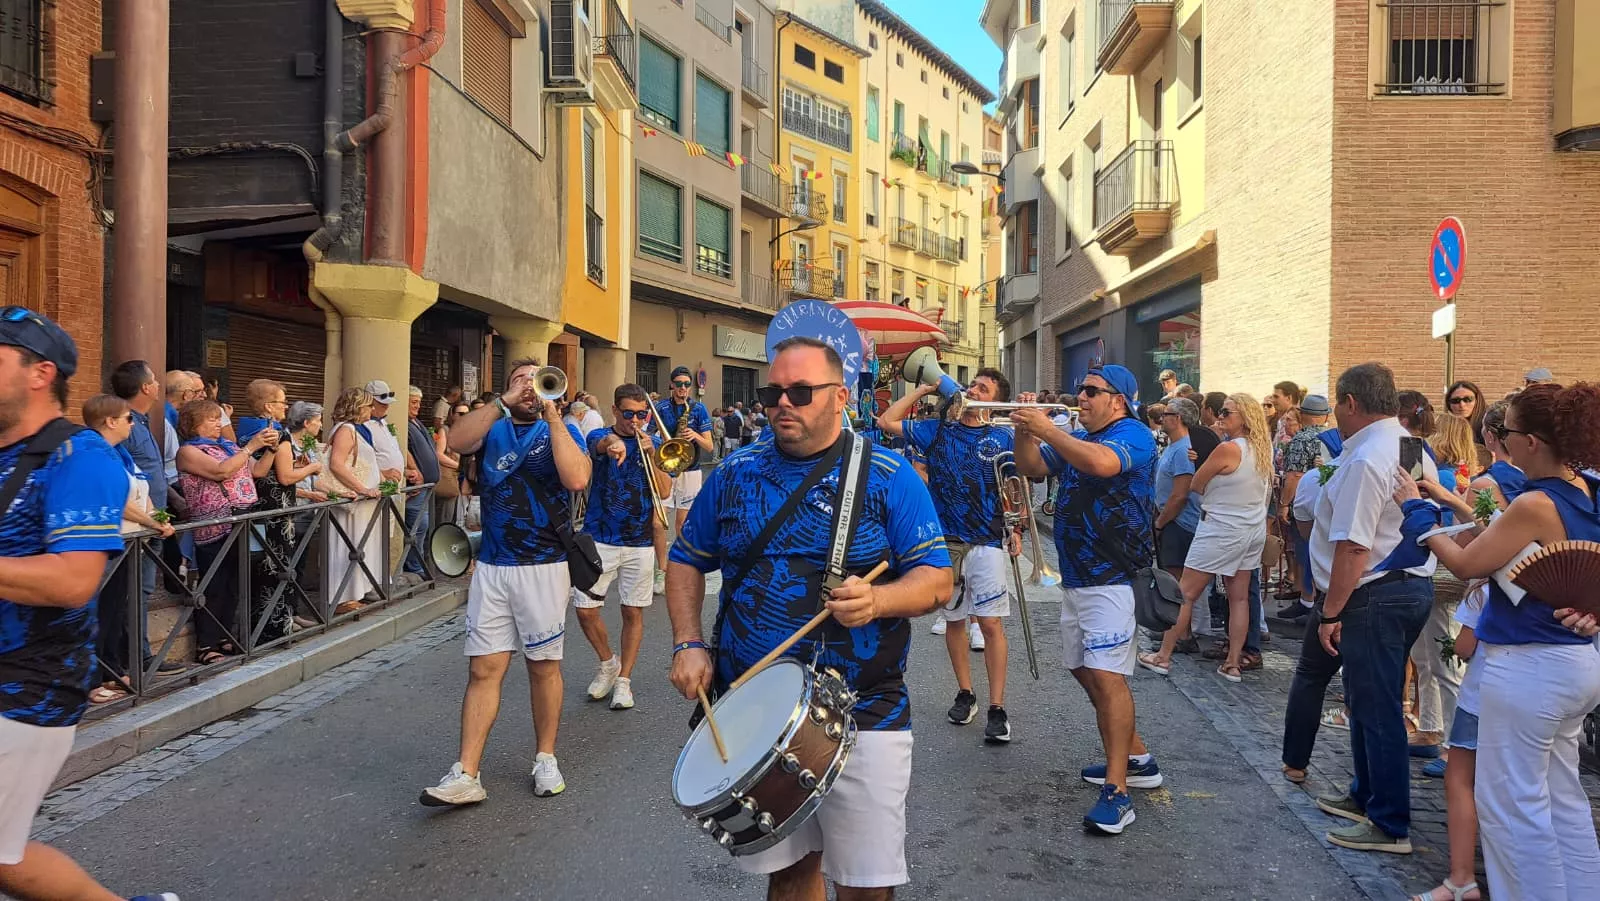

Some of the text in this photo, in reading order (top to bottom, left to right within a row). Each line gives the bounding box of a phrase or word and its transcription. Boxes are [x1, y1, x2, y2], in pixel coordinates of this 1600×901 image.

[775, 301, 847, 330] CHARANGA
[832, 490, 853, 568] GUITAR STRA
